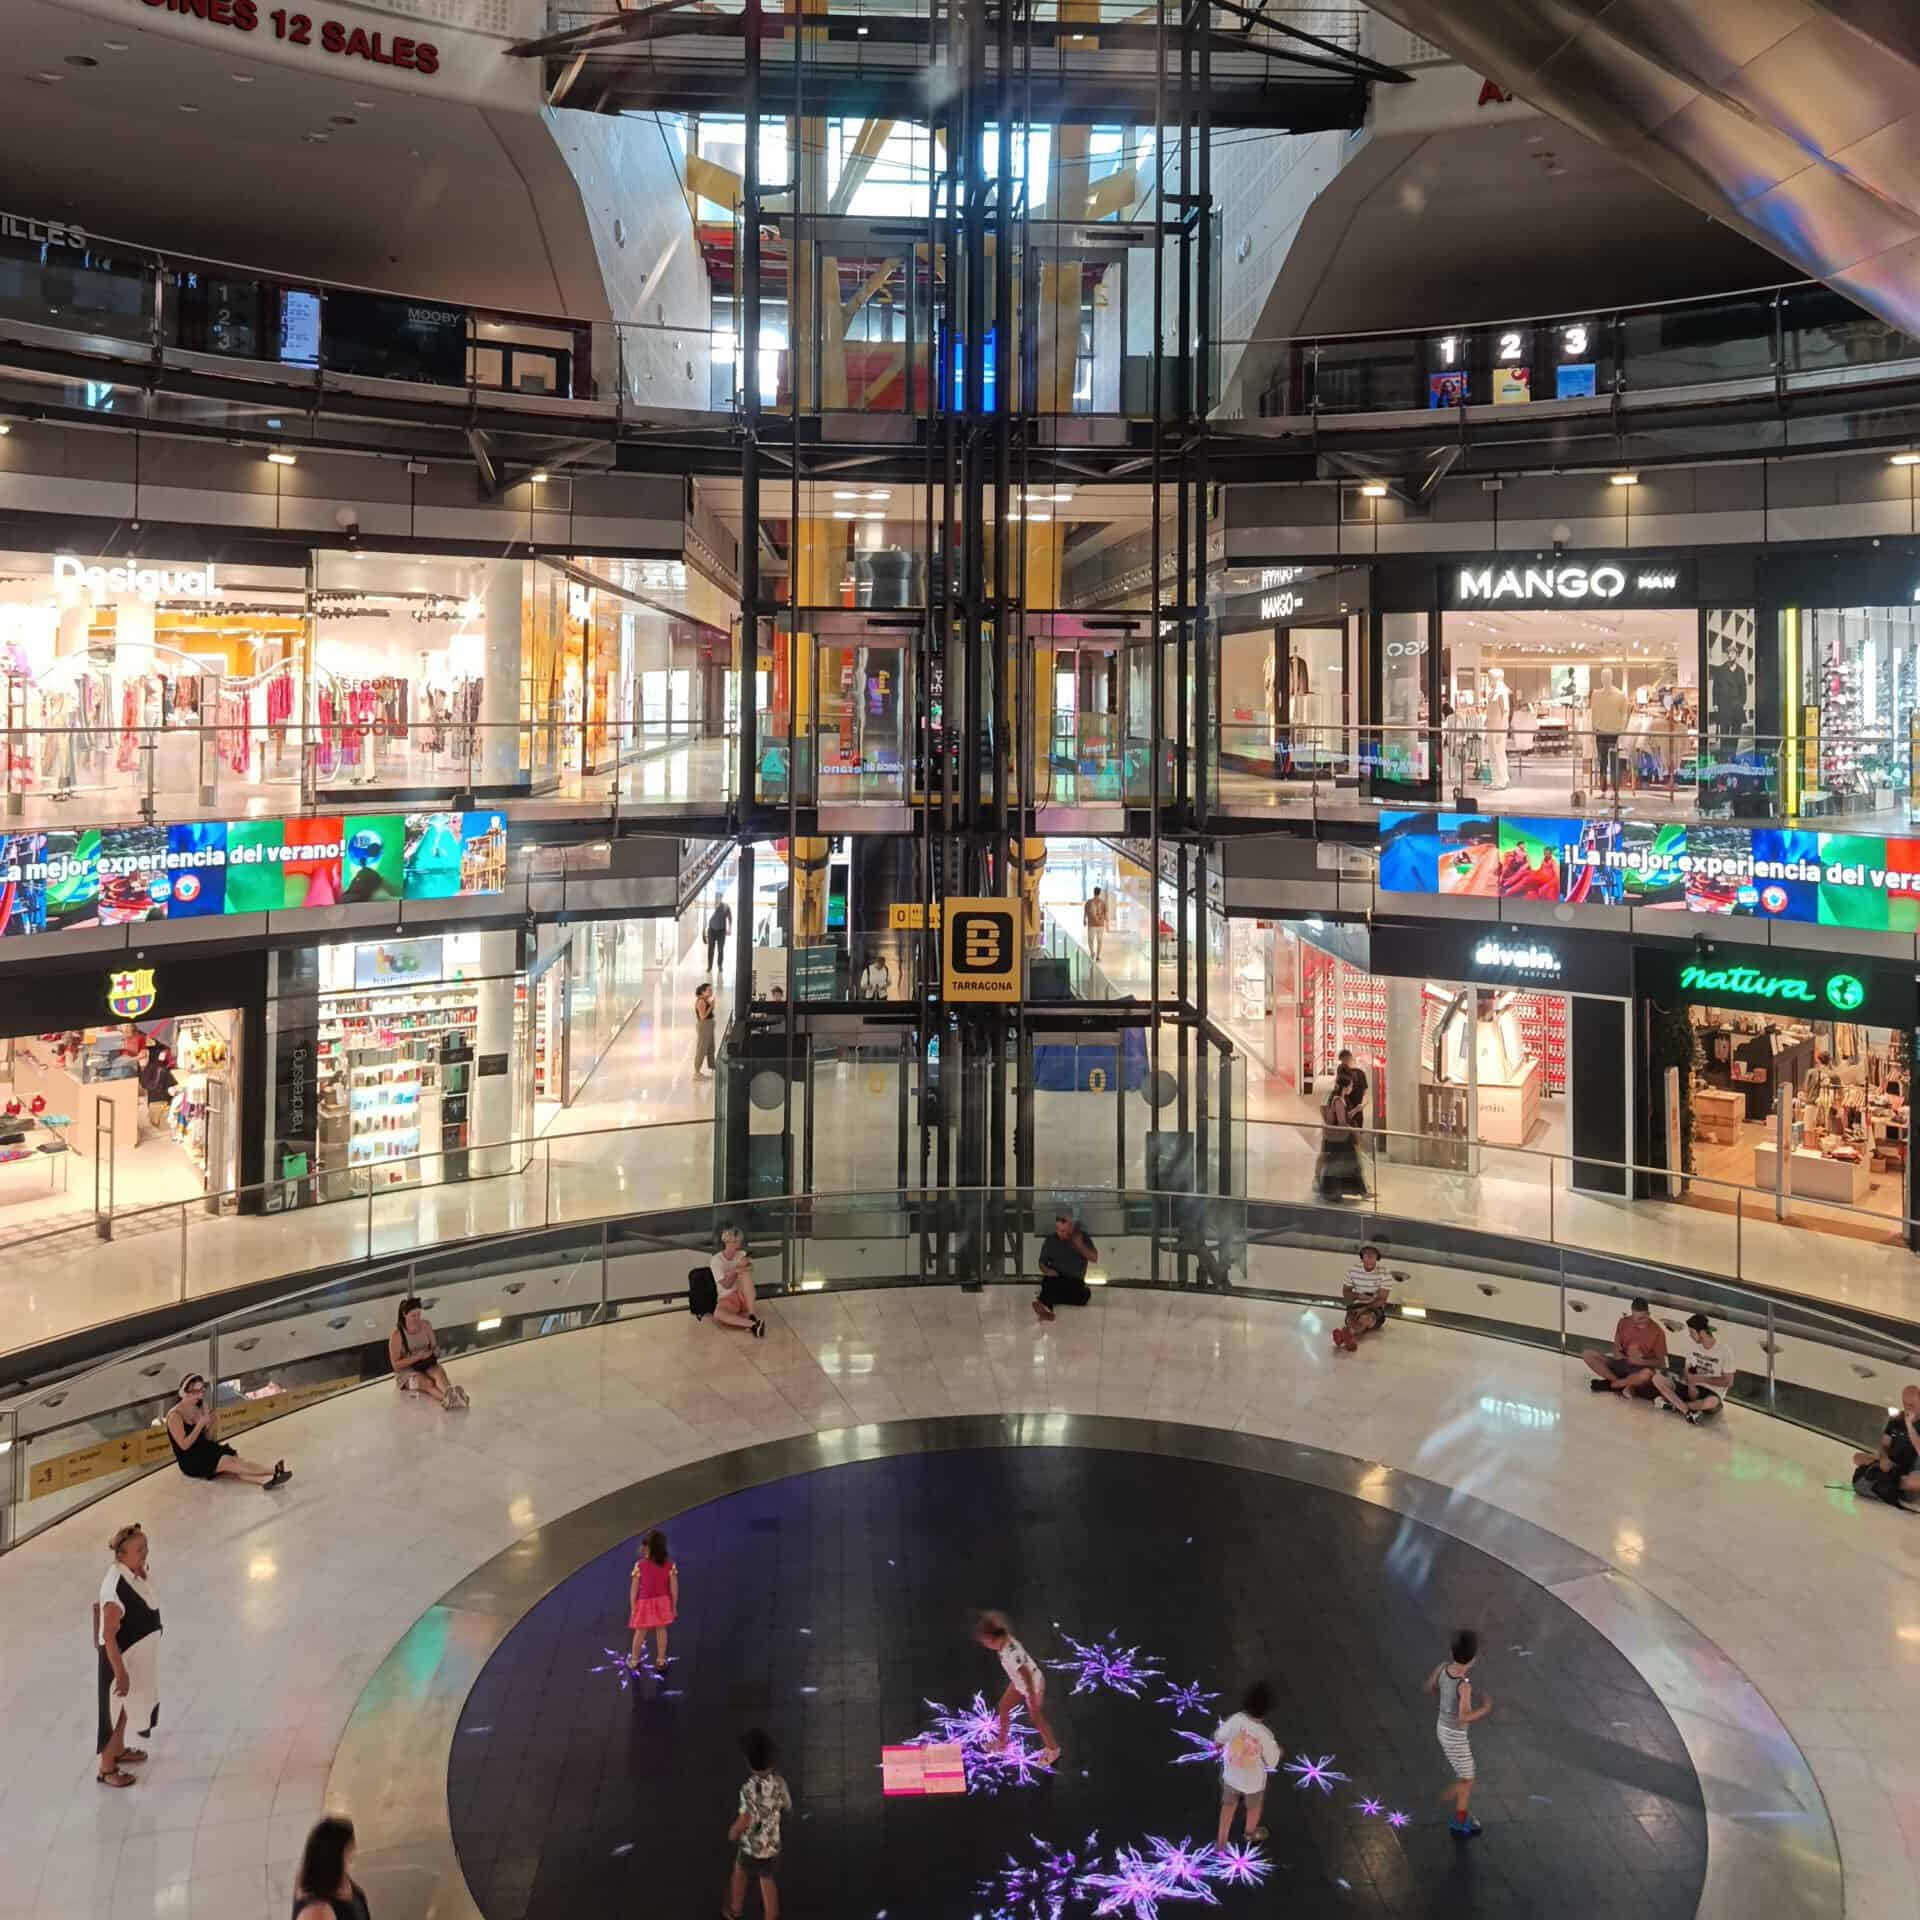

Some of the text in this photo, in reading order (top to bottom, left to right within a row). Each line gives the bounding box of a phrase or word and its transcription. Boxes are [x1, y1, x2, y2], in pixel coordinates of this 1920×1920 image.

[271, 9, 312, 45] 12
[321, 21, 439, 74] SALES
[1441, 338, 1456, 363] 1
[1501, 334, 1521, 359] 2
[1565, 328, 1587, 354] 3
[1459, 566, 1679, 600] MANGO MAN
[25, 855, 92, 882] mejor
[96, 845, 226, 877] experiencia
[229, 843, 263, 864] del
[266, 839, 346, 862] verano!
[1604, 846, 1673, 875] mejor
[1678, 852, 1821, 882] experiencia
[1826, 863, 1864, 887] del
[897, 910, 906, 922] 0
[952, 981, 1013, 991] TARRAGONA
[1681, 965, 1817, 1001] natura
[289, 1047, 307, 1133] hairdressing
